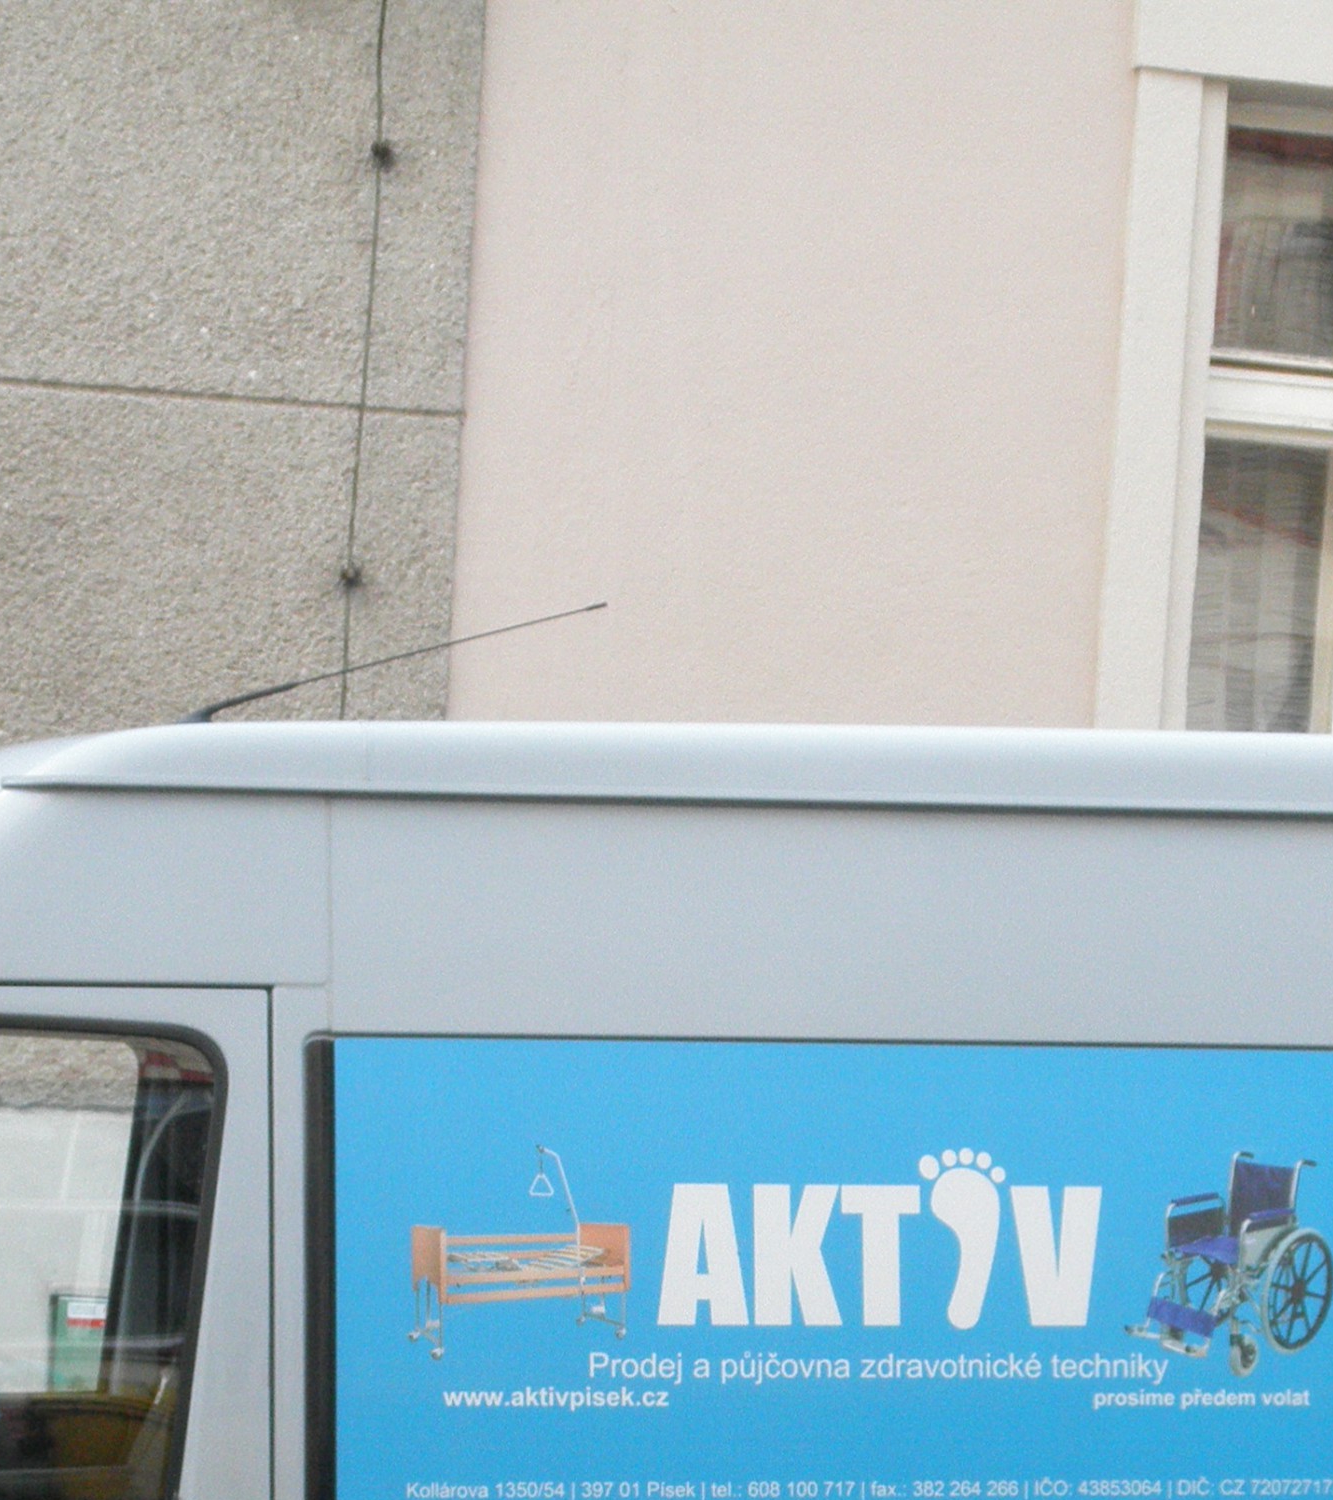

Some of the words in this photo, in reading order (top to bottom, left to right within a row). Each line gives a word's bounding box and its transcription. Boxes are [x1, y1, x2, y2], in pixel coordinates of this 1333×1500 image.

[587, 1352, 684, 1385] Prodej
[693, 1357, 710, 1379] a
[720, 1350, 850, 1385] půjčovna
[860, 1352, 1043, 1380] zdravotnické
[1051, 1353, 1169, 1386] techniky
[442, 1386, 670, 1412] www.aktivpisek.cz
[1092, 1388, 1175, 1410] prosíme
[1180, 1388, 1255, 1410] předem
[1261, 1388, 1311, 1407] volat
[405, 1481, 489, 1499] Kollárova
[495, 1481, 565, 1499] 1350/54
[581, 1481, 613, 1498] 397
[619, 1481, 641, 1498] 01
[647, 1480, 696, 1498] Písek
[711, 1481, 742, 1498] tel.:
[747, 1481, 780, 1498] 608
[787, 1481, 817, 1498] 100
[823, 1481, 855, 1497] 717
[870, 1480, 907, 1497] fax.:
[913, 1480, 944, 1497] 382
[950, 1480, 981, 1497] 264
[986, 1480, 1019, 1497] 266
[1034, 1477, 1073, 1497] IČO:
[1077, 1479, 1162, 1496] 43853064
[1176, 1476, 1214, 1496] DIČ:
[1219, 1479, 1245, 1496] CZ
